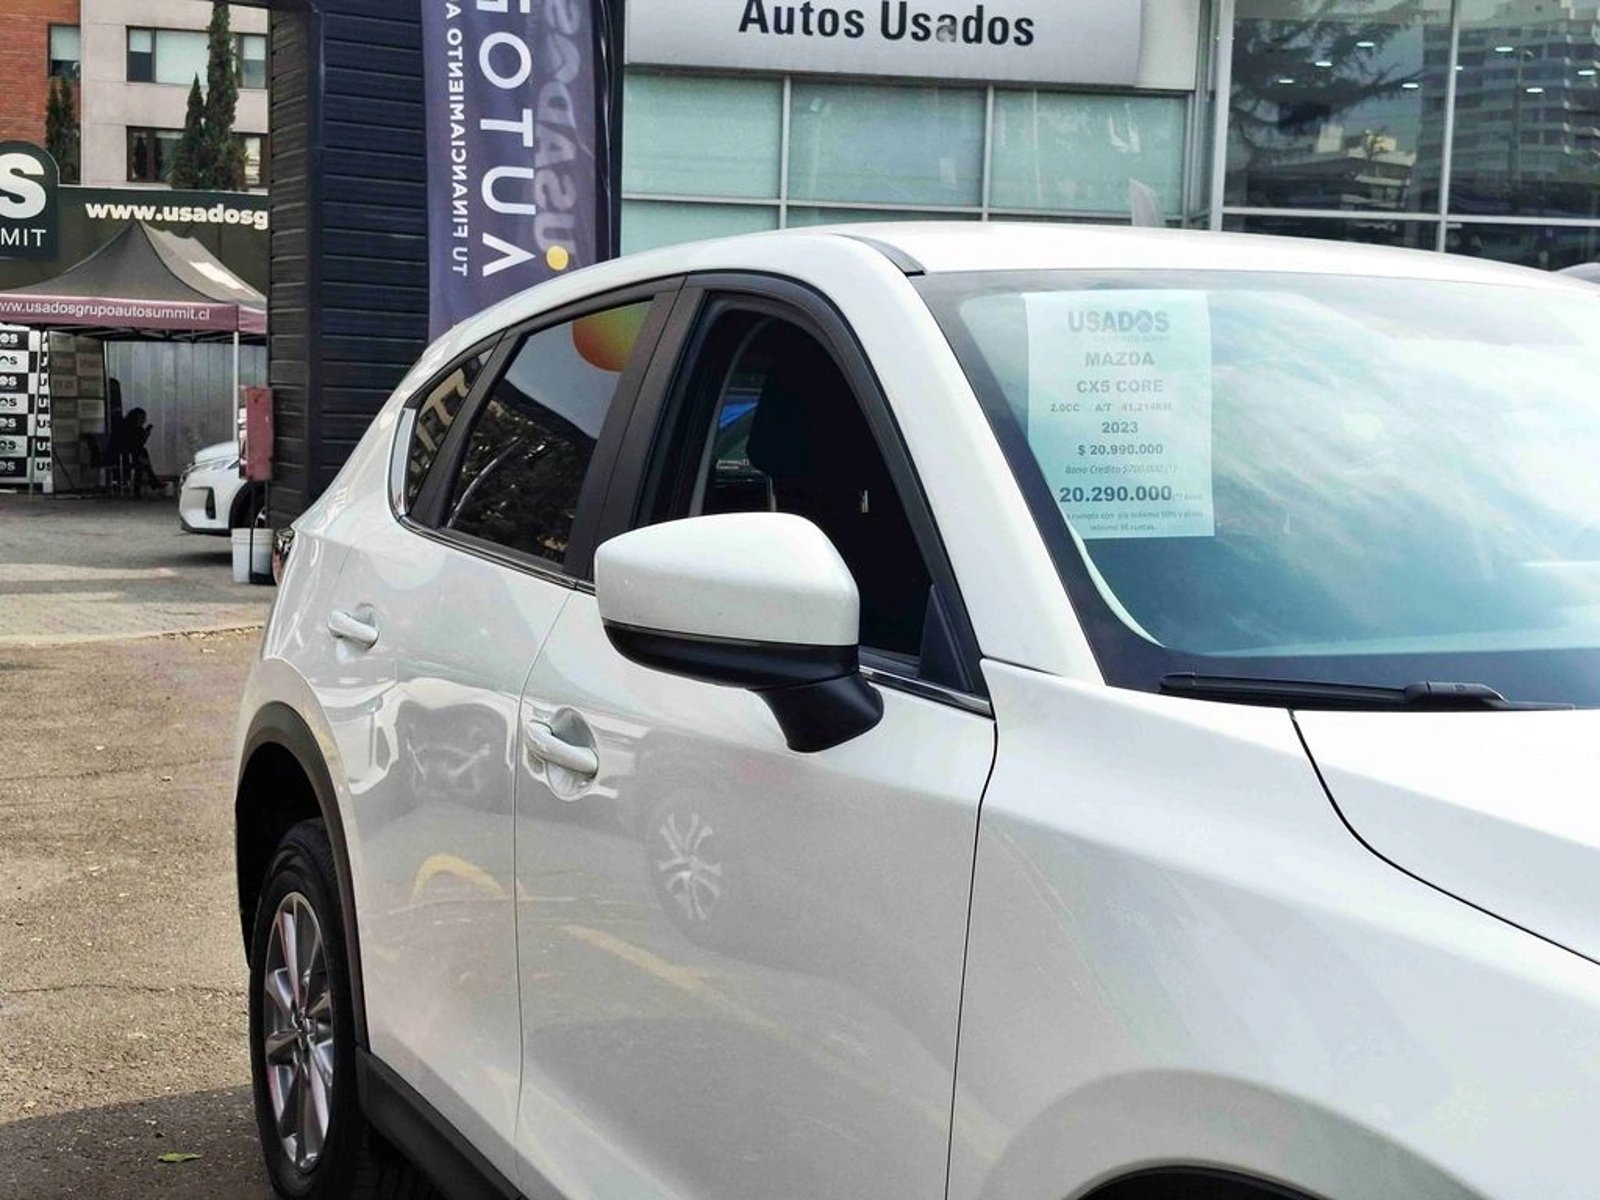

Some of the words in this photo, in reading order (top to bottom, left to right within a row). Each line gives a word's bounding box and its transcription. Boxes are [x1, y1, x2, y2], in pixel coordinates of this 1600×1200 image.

[738, 0, 864, 39] Autos
[880, 0, 1035, 46] Usados
[1068, 310, 1170, 333] USADOS
[1085, 351, 1155, 367] MAZDA
[1076, 380, 1110, 394] CX5
[1116, 380, 1164, 393] CORE
[1101, 421, 1138, 434] 2023
[1090, 443, 1164, 456] 20.990.000
[1059, 485, 1173, 503] 20.290.000
